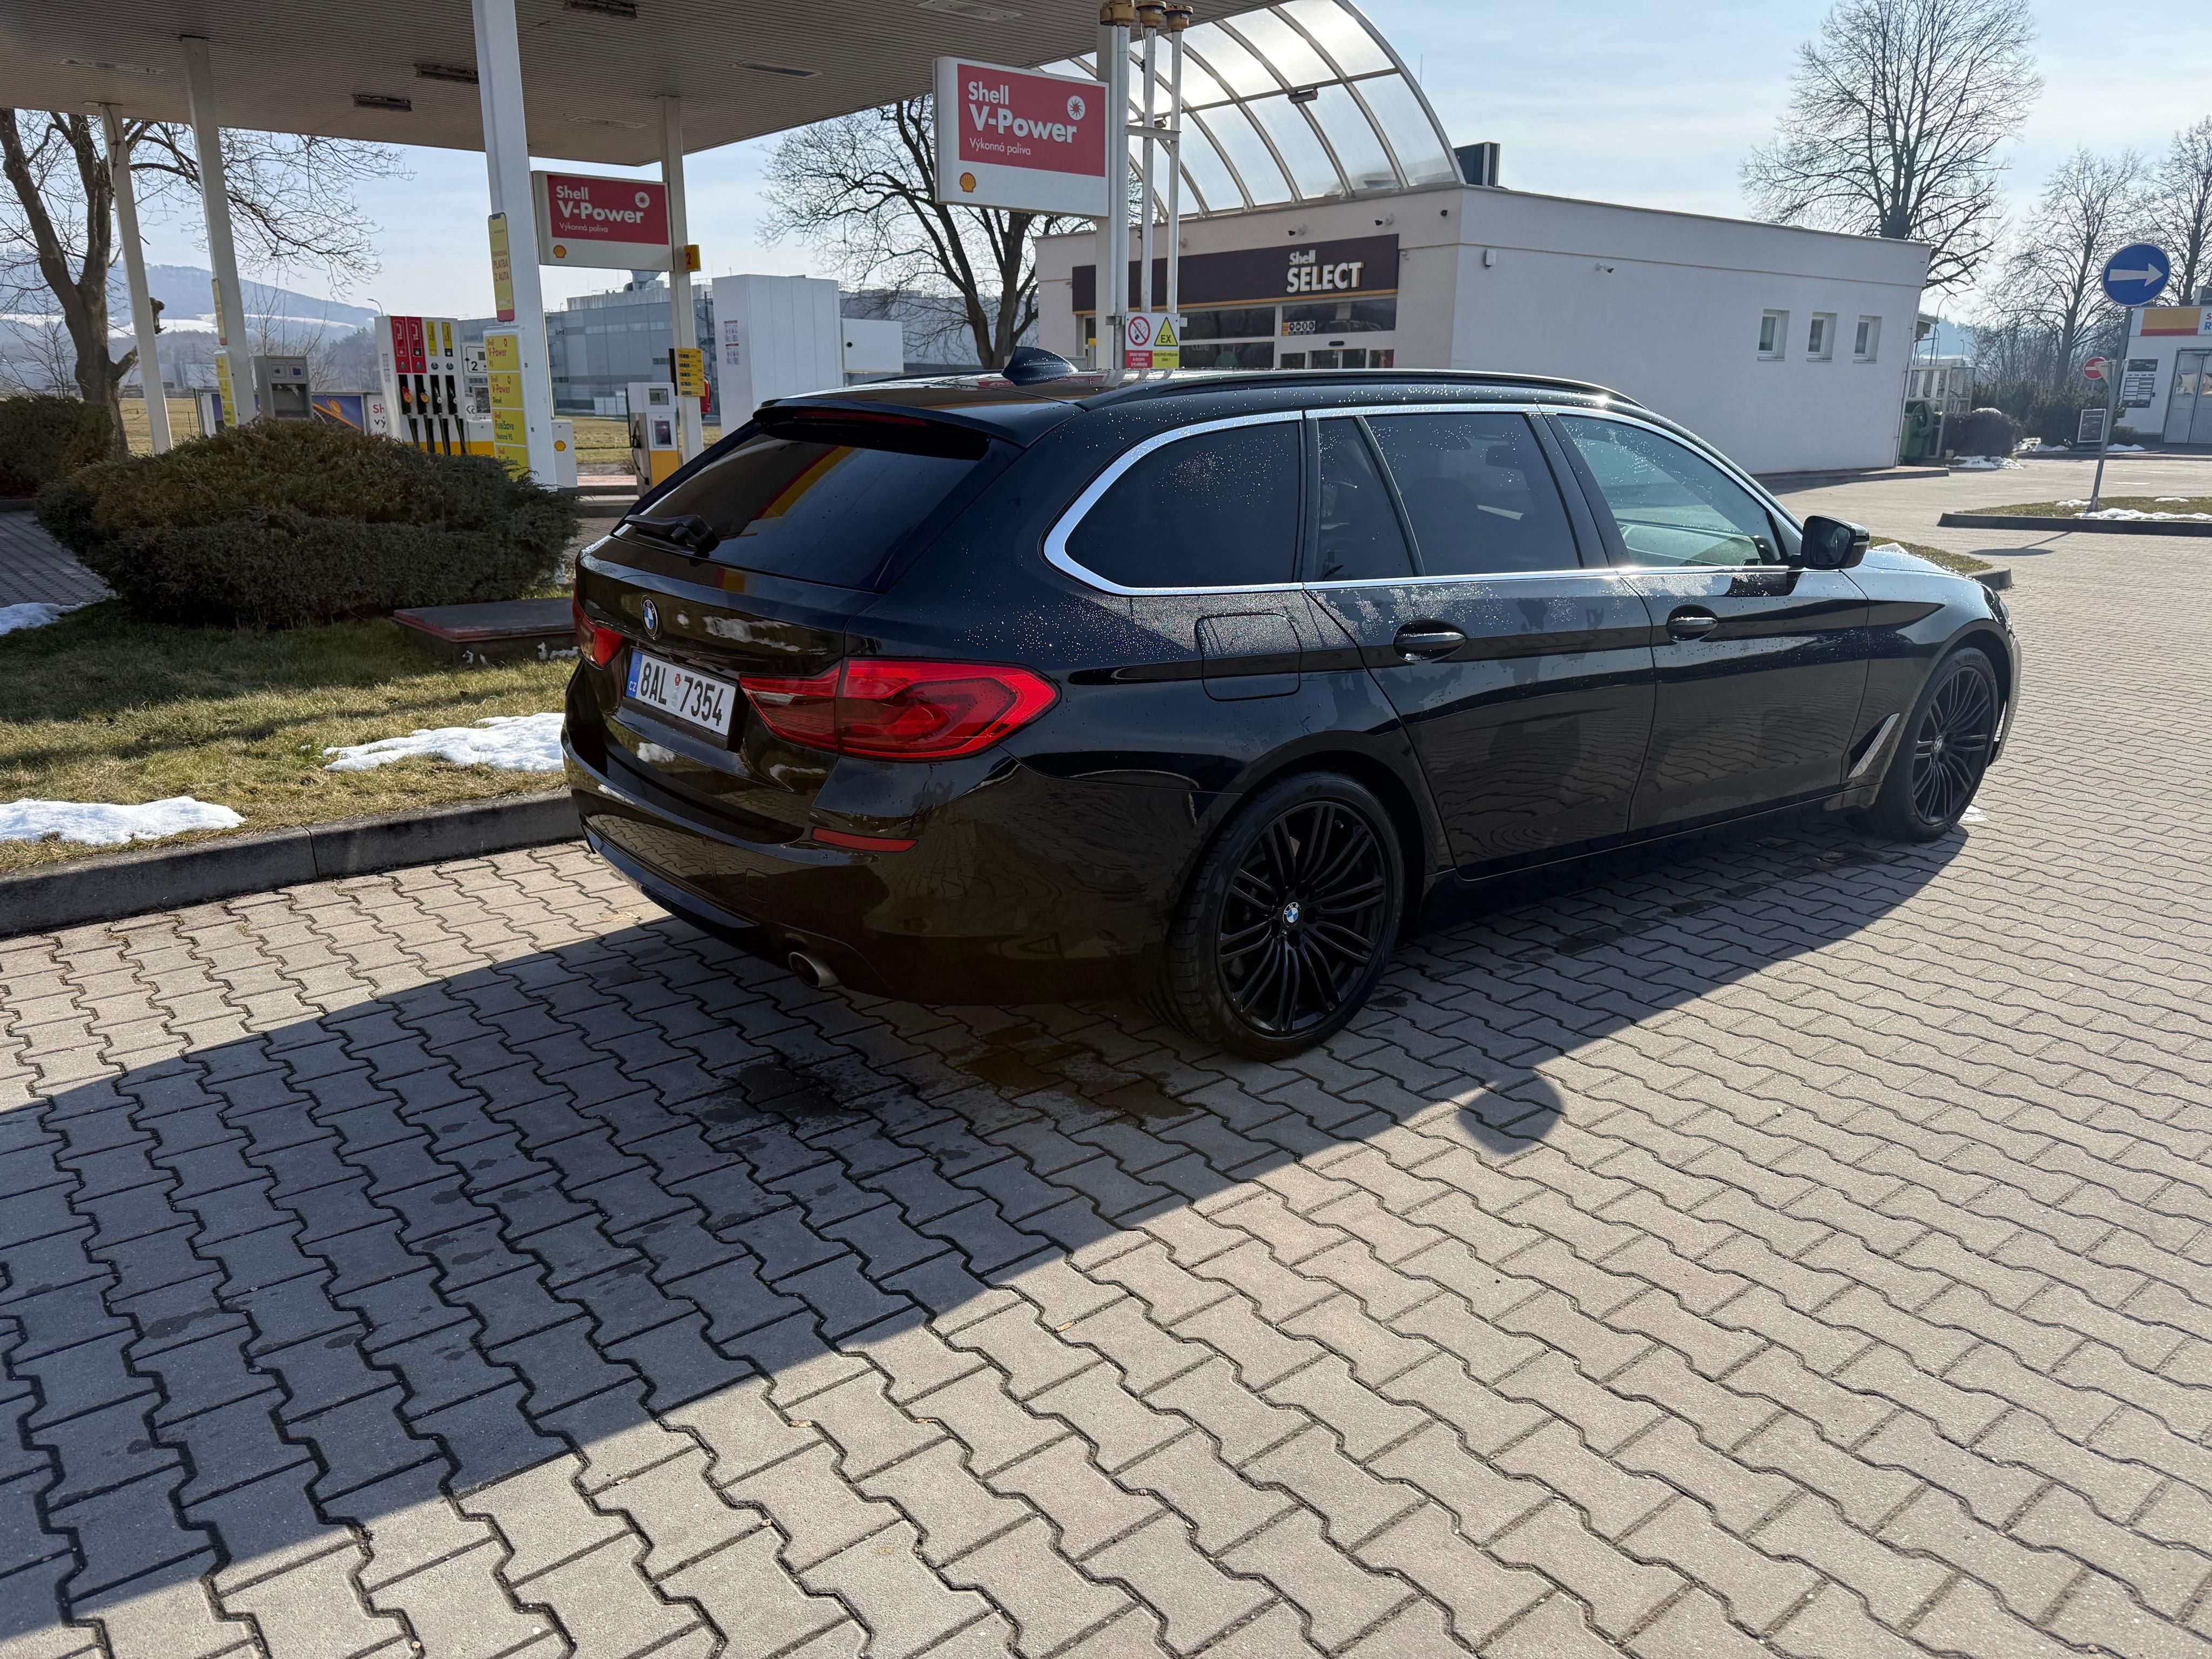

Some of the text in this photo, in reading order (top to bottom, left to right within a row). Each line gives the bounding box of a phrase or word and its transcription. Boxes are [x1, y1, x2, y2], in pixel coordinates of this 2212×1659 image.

[968, 81, 1009, 105] Shell
[968, 103, 1077, 143] V-Power
[969, 137, 1031, 155] Výkonná paliva
[556, 185, 589, 200] Shell
[557, 200, 644, 223] V-Power
[559, 222, 587, 232] Výkonná
[686, 253, 691, 264] 2
[1289, 249, 1316, 265] Shell
[1286, 261, 1364, 293] SELECT
[1161, 335, 1171, 343] EX
[488, 347, 507, 356] V-Power
[471, 361, 478, 371] 2
[491, 383, 510, 393] V-Power
[629, 681, 637, 692] CZ
[640, 662, 724, 726] 8AL 7354
